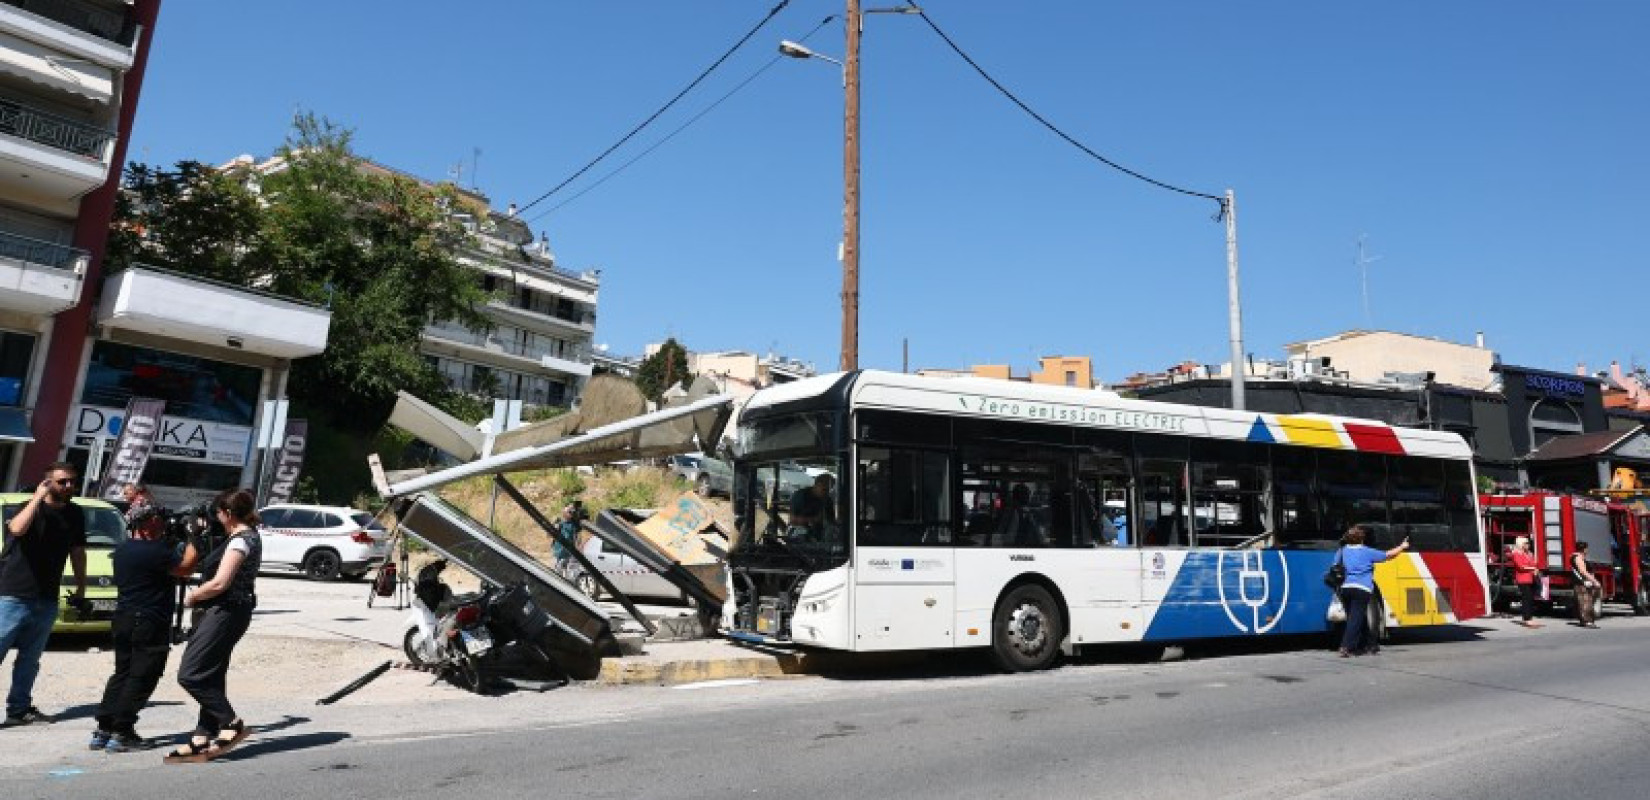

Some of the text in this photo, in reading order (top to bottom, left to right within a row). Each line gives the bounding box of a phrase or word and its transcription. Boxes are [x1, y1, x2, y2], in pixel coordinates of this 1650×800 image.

[1526, 375, 1585, 395] SCORPIOS
[78, 408, 208, 447] DOKA
[979, 397, 1184, 432] Zero emission ELECTRIC
